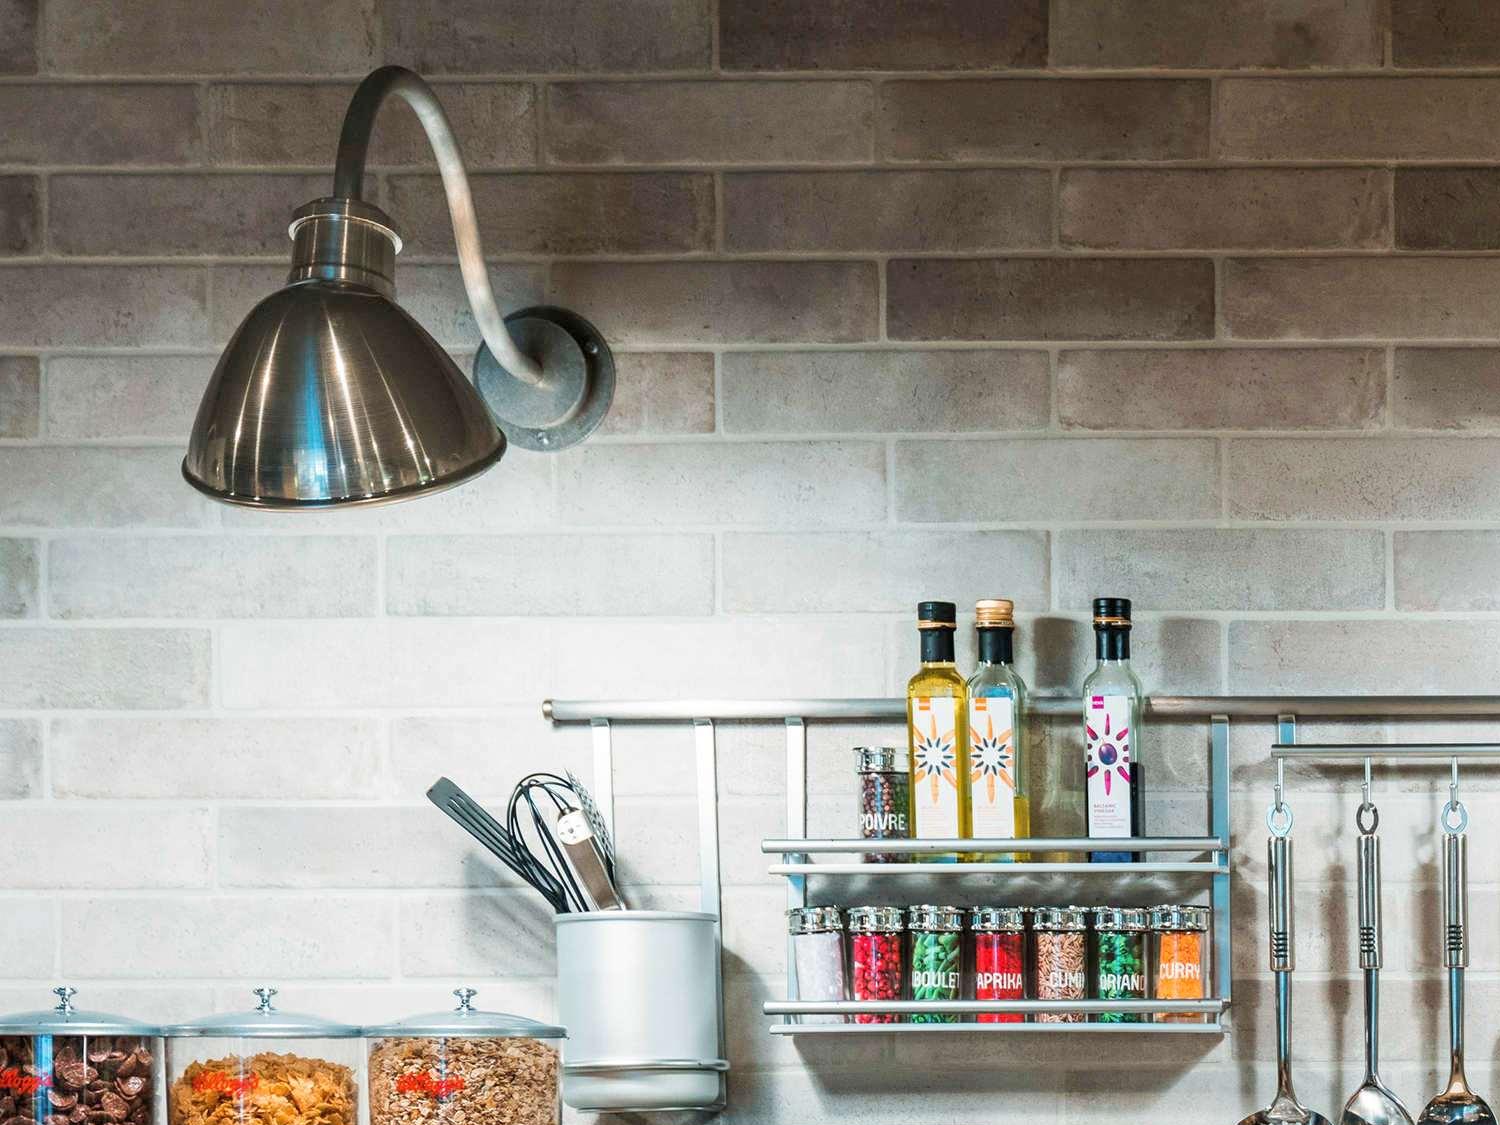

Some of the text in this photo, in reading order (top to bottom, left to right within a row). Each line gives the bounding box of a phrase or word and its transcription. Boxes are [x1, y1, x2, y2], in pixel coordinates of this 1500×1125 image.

[859, 813, 905, 830] POIVRE
[1160, 963, 1200, 979] CURRY
[977, 972, 1022, 990] APRIKA
